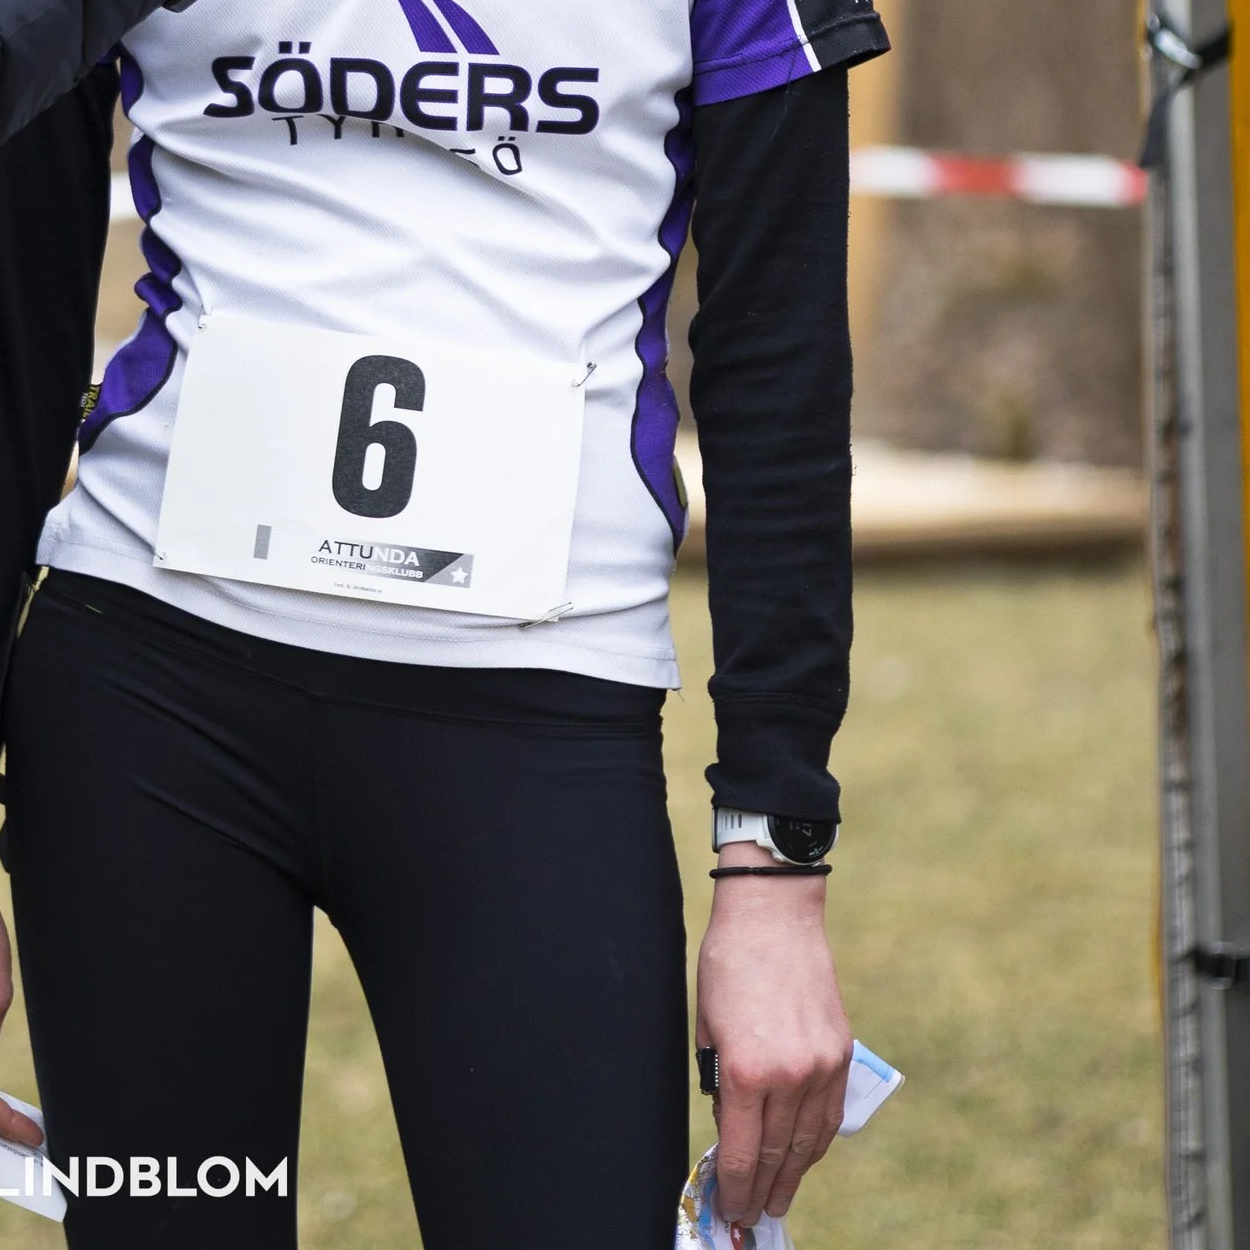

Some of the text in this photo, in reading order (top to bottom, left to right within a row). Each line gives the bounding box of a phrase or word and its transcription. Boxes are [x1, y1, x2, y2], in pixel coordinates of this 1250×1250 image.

[203, 40, 600, 135] SÖDERS
[331, 354, 426, 519] 6
[310, 556, 424, 579] ORIENTERINGSKLUBB
[318, 539, 420, 566] ATTUNDA
